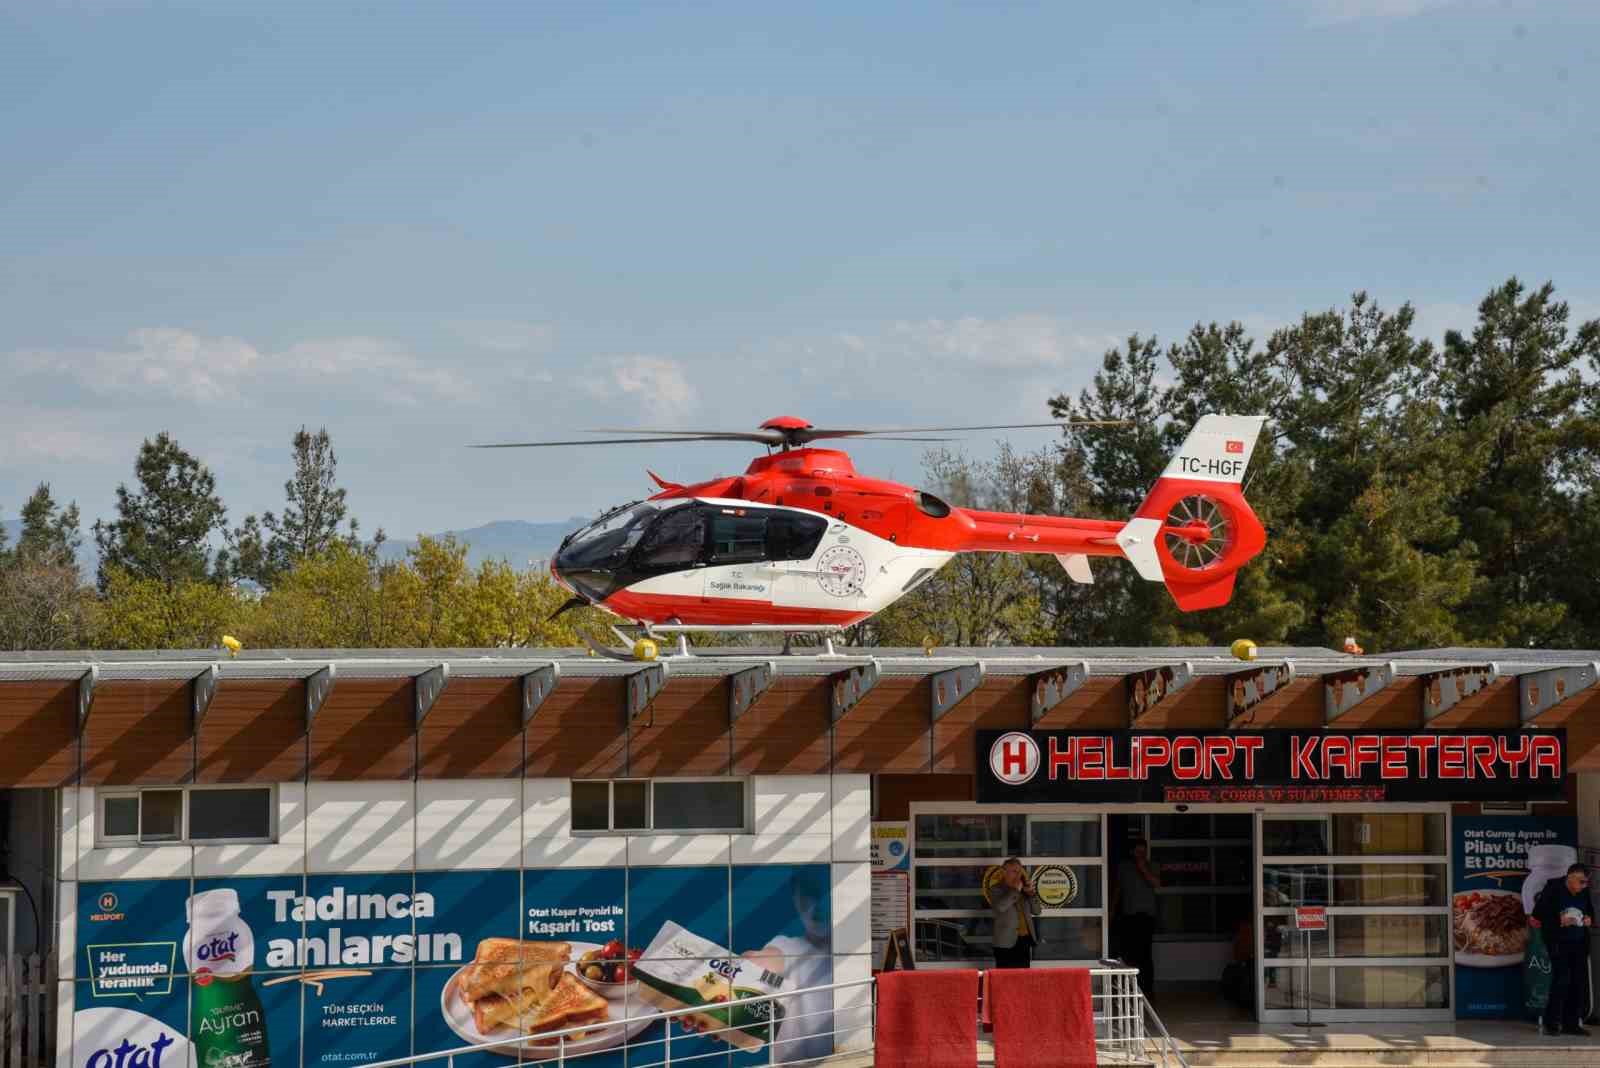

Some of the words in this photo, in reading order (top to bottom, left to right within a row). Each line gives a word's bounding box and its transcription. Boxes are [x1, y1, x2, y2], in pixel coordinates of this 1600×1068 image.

[1180, 457, 1244, 476] TC-HGF
[1290, 735, 1561, 779] KAFETERYA
[1464, 840, 1502, 854] Pilav
[1464, 855, 1482, 869] Et
[266, 886, 435, 922] Tadınca
[528, 908, 550, 918] Otat
[551, 908, 577, 919] Kaşar
[579, 906, 611, 918] Peyniri
[528, 920, 580, 936] Kaşarlı
[583, 919, 615, 932] Tost
[197, 931, 239, 961] otat
[265, 927, 462, 967] anlarsın
[100, 951, 126, 963] Her
[99, 962, 168, 978] yudumda
[709, 959, 743, 978] otat
[322, 1004, 345, 1015] TÜM
[347, 1003, 384, 1016] SEÇKİN
[200, 1009, 260, 1035] Ayran
[322, 1015, 398, 1027] MARKETLERDE
[321, 1051, 378, 1062] otat.com.tr
